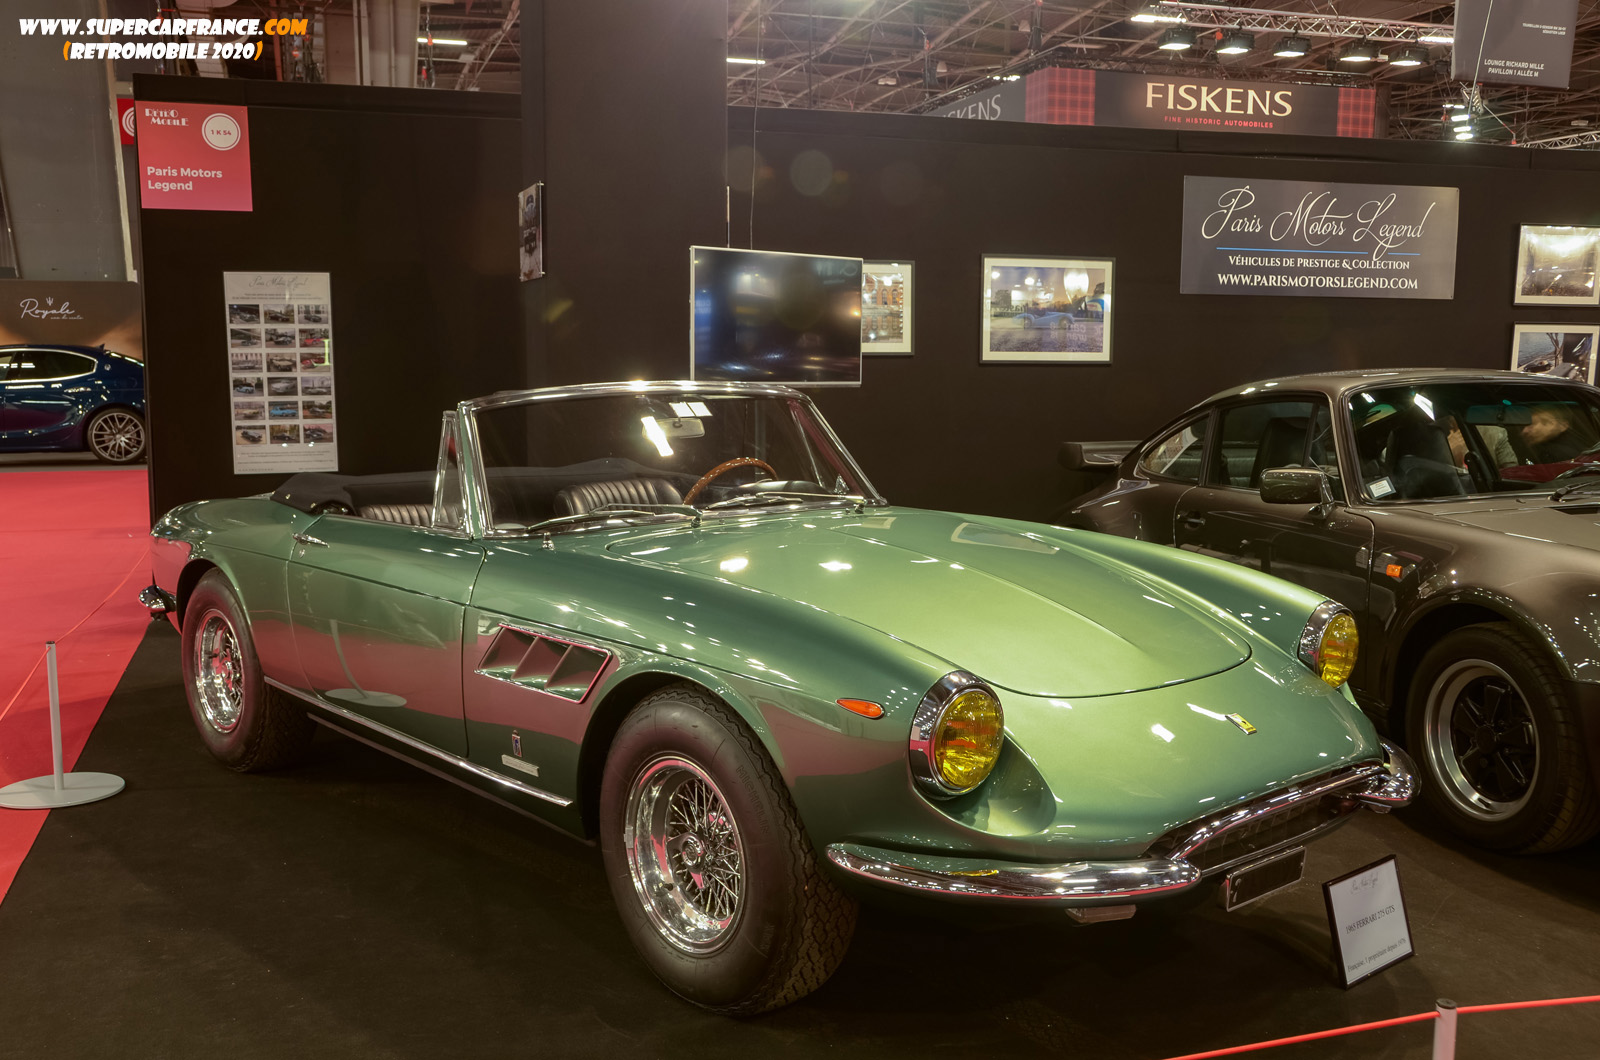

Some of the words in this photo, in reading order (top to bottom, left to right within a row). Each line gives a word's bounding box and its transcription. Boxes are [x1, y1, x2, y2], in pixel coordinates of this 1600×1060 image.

[1484, 59, 1506, 67] LOUNGE
[1506, 60, 1529, 69] RICHARD
[1488, 67, 1513, 75] PAVILLON
[1145, 82, 1293, 117] FISKENS
[1186, 118, 1221, 126] HISTORIC
[1224, 120, 1274, 129] AUTOMOBILES
[147, 166, 178, 177] Paris
[181, 167, 223, 178] Motors
[148, 180, 193, 192] Legend
[1201, 185, 1263, 239] Paris
[1270, 191, 1353, 246] Motors
[1353, 192, 1436, 261] Legend
[1228, 254, 1281, 267] VÉHICULES
[1282, 257, 1295, 267] DE
[1297, 257, 1340, 269] PRESTIGE
[1352, 259, 1410, 270] COLLECTION
[1217, 273, 1418, 290] WWW.PARISMOTORSLEGEND.COM
[20, 298, 75, 319] Royale
[736, 764, 769, 834] MICHELIN
[1355, 912, 1378, 930] FERRARI
[1385, 904, 1396, 916] GTS
